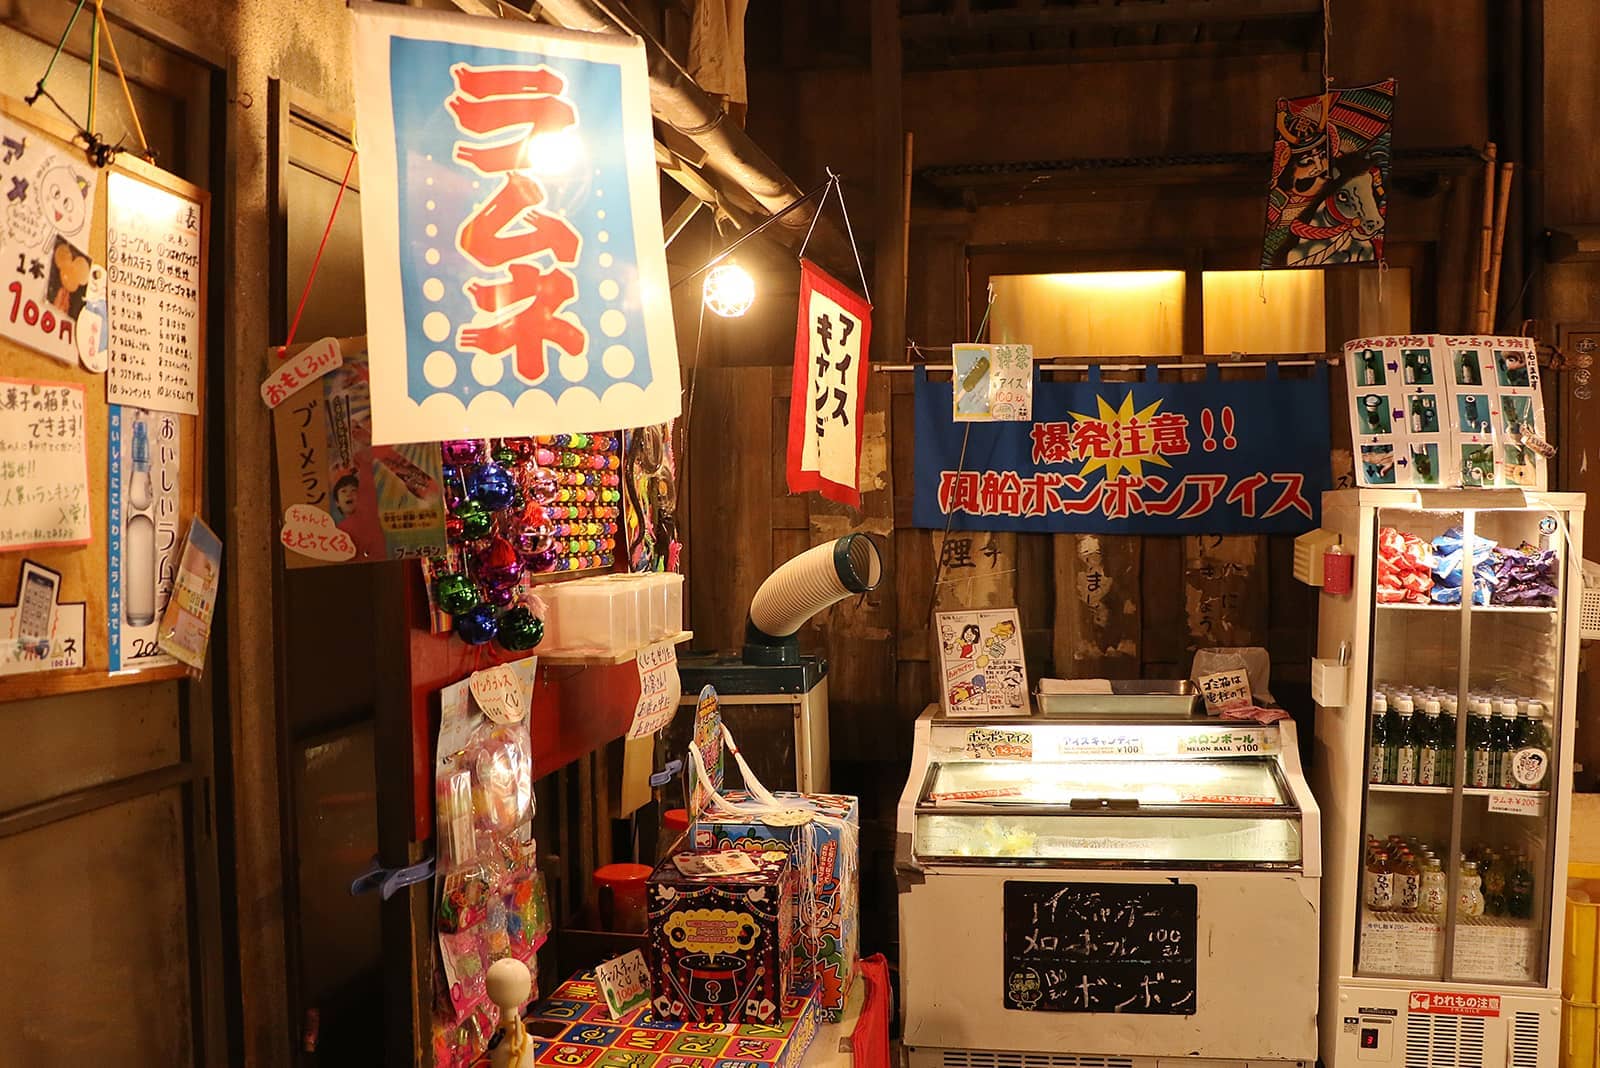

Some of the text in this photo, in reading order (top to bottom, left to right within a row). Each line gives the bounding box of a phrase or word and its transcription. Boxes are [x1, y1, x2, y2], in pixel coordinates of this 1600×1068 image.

[447, 64, 588, 384] ラムネ
[9, 281, 73, 345] 100円
[266, 343, 337, 406] おもしろい!
[832, 313, 855, 427] アイス
[1000, 377, 1024, 389] アイス
[0, 388, 82, 411] 菓子の箱買い
[28, 414, 83, 439] できます!
[293, 399, 326, 506] ブーメラン
[938, 470, 1313, 520] 風船ボンボンアイス
[291, 509, 329, 526] ちゃんと
[1203, 675, 1242, 691] ゴミ箱は
[968, 730, 1030, 743] ボンボンアイス
[1065, 736, 1139, 745] アイスキャンディー
[1188, 734, 1254, 744] メロンボール
[1236, 744, 1259, 752] ¥100
[1117, 745, 1139, 753] ¥100
[1074, 972, 1194, 1012] ボンボン
